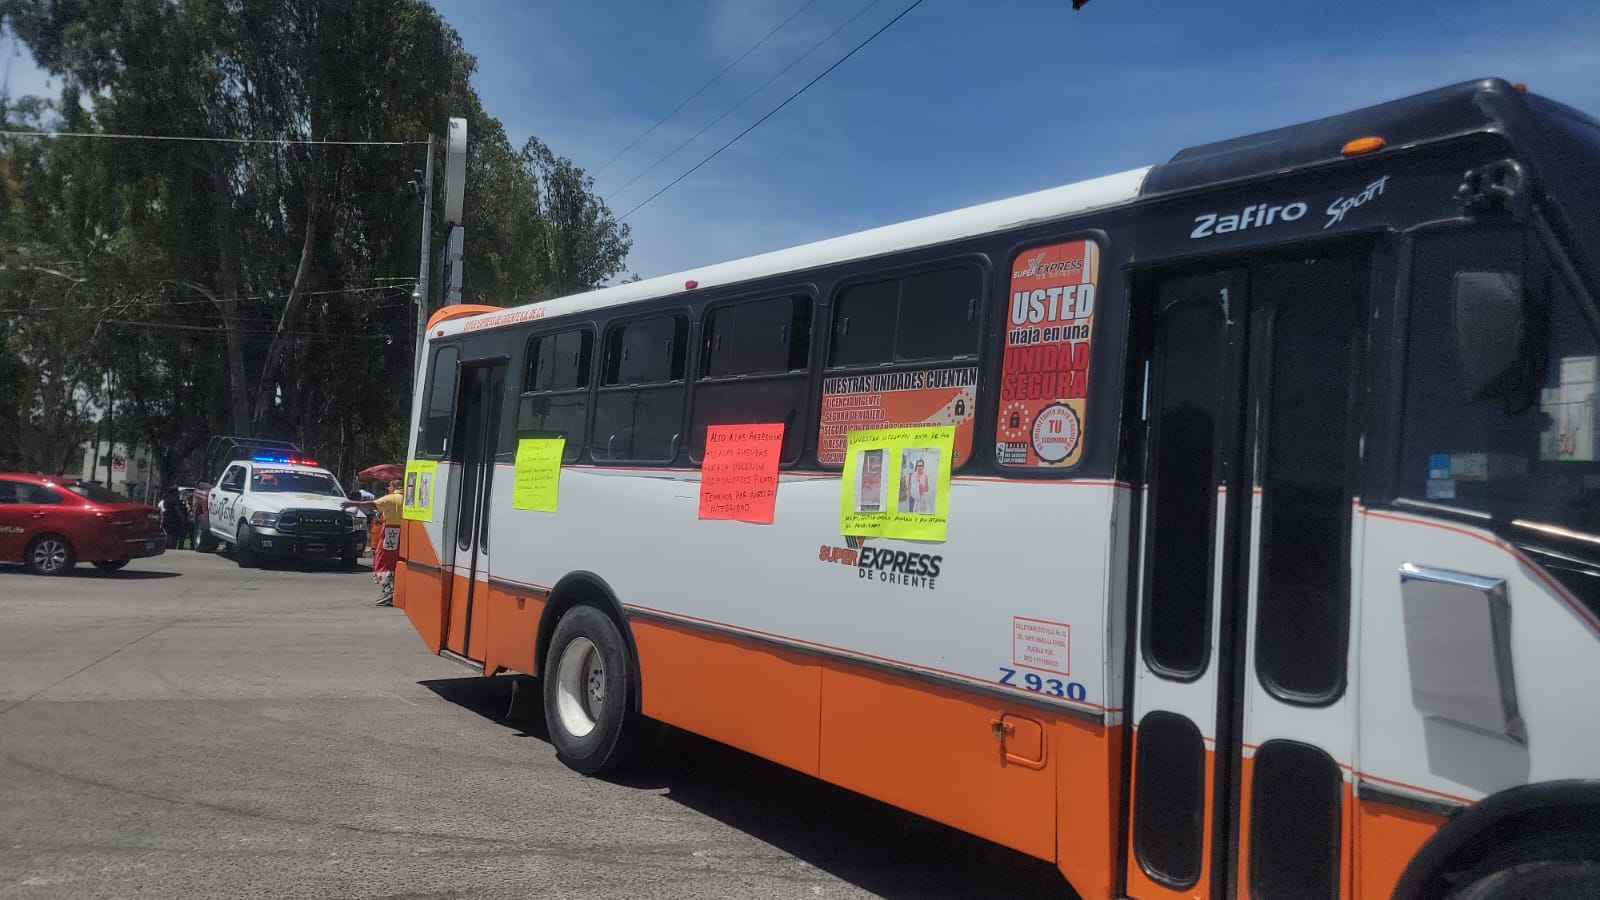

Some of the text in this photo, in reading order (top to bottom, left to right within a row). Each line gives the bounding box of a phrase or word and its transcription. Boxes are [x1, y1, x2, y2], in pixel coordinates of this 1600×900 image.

[1190, 175, 1391, 239] Zafiro Sport
[1037, 259, 1084, 275] EXPRESS
[1011, 283, 1096, 326] USTED
[1009, 325, 1089, 345] viaja en una
[1004, 343, 1090, 374] UNIDAD
[823, 367, 978, 395] NUESTRAS UNIDADES CUENTAN
[1001, 371, 1087, 400] SEGURA
[1048, 420, 1063, 434] TU
[819, 544, 943, 578] SUPER EXPRESS
[859, 568, 935, 590] DE ORIENTE
[999, 667, 1087, 701] Z 930
